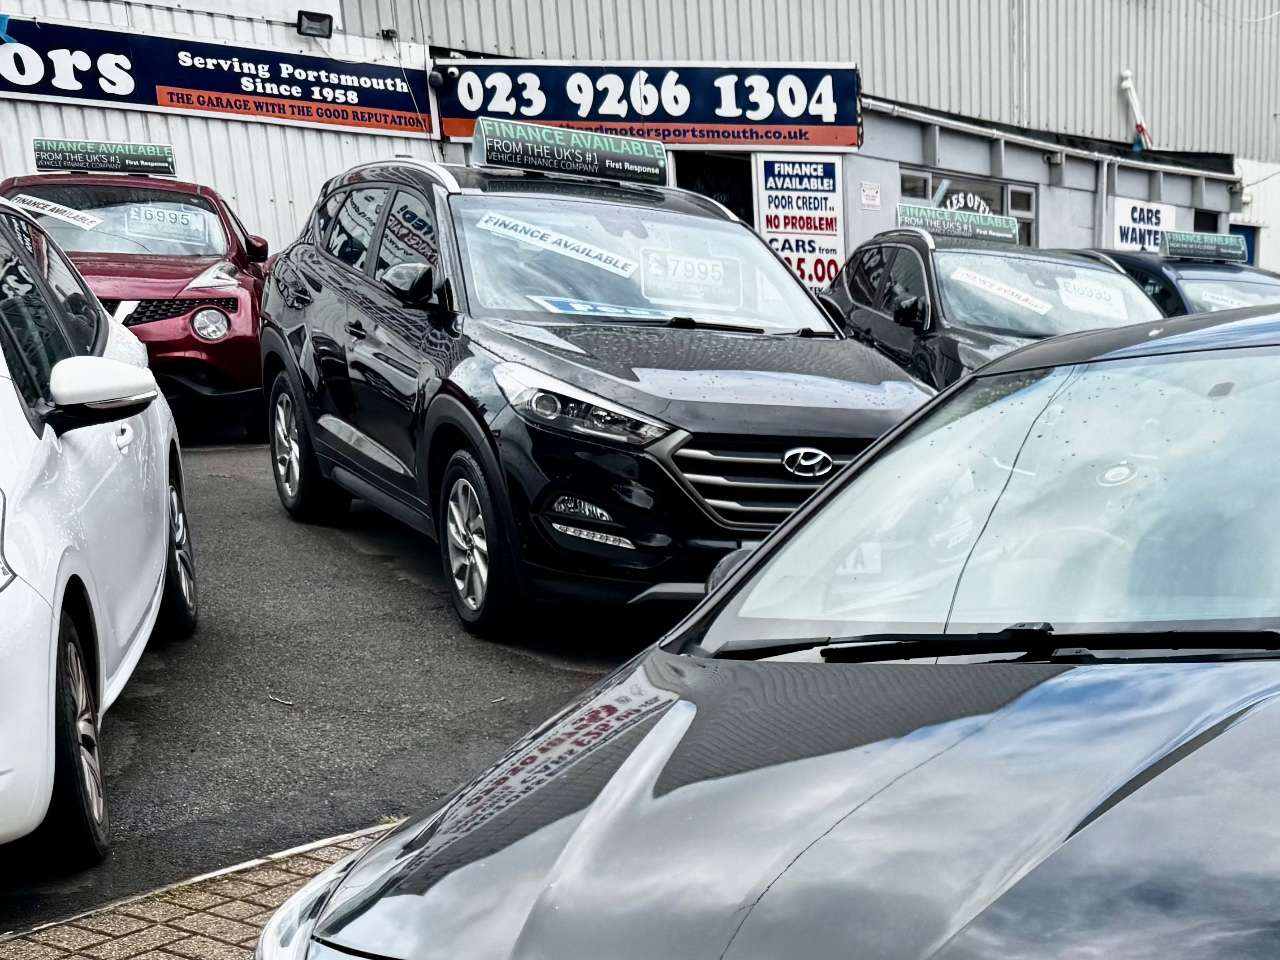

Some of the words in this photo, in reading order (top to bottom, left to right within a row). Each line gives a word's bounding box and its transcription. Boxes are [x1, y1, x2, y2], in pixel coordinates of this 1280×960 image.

[0, 42, 135, 95] ors
[177, 51, 270, 79] Serving
[279, 63, 410, 93] Portsmouth
[240, 76, 302, 97] Since
[311, 86, 359, 104] 1958
[457, 71, 546, 118] 023
[566, 70, 691, 119] 9266
[713, 74, 838, 123] 1304
[167, 91, 193, 105] THE
[197, 95, 250, 111] GARAGE
[254, 101, 286, 115] WITH
[289, 105, 313, 117] THE
[316, 108, 349, 120] GOOD
[352, 111, 427, 128] REPUTATION
[34, 140, 94, 152] FINANCE
[99, 144, 173, 157] AVAILABLE
[483, 120, 565, 145] FINANCE
[570, 133, 665, 159] AVAILABLE
[35, 152, 62, 161] FROM
[64, 153, 82, 162] THE
[85, 154, 107, 163] UK'S
[486, 139, 524, 154] FROM
[526, 143, 551, 158] THE
[554, 146, 583, 163] UK'S
[585, 152, 599, 165] #1
[487, 151, 522, 164] VEHICLE
[524, 156, 558, 169] FINANCE
[560, 161, 599, 173] COMPANY
[606, 159, 623, 170] First
[624, 161, 660, 175] Response
[774, 163, 824, 176] FINANCE
[767, 177, 833, 191] AVAILABLE!
[13, 196, 49, 211] FINANCE
[49, 207, 97, 226] AVAILABLE
[768, 195, 793, 210] POOR
[766, 215, 780, 230] NO
[784, 216, 837, 232] PROBLEM!
[900, 206, 951, 220] FINANCE
[955, 212, 1017, 229] AVAILABLE
[900, 216, 924, 226] FROM
[925, 219, 942, 229] THE
[1131, 206, 1160, 226] CARS
[484, 215, 550, 242] FINANCE
[552, 237, 633, 273] AVAILABLE
[769, 238, 816, 254] CARS
[819, 247, 837, 255] from
[1119, 225, 1163, 247] WANTE
